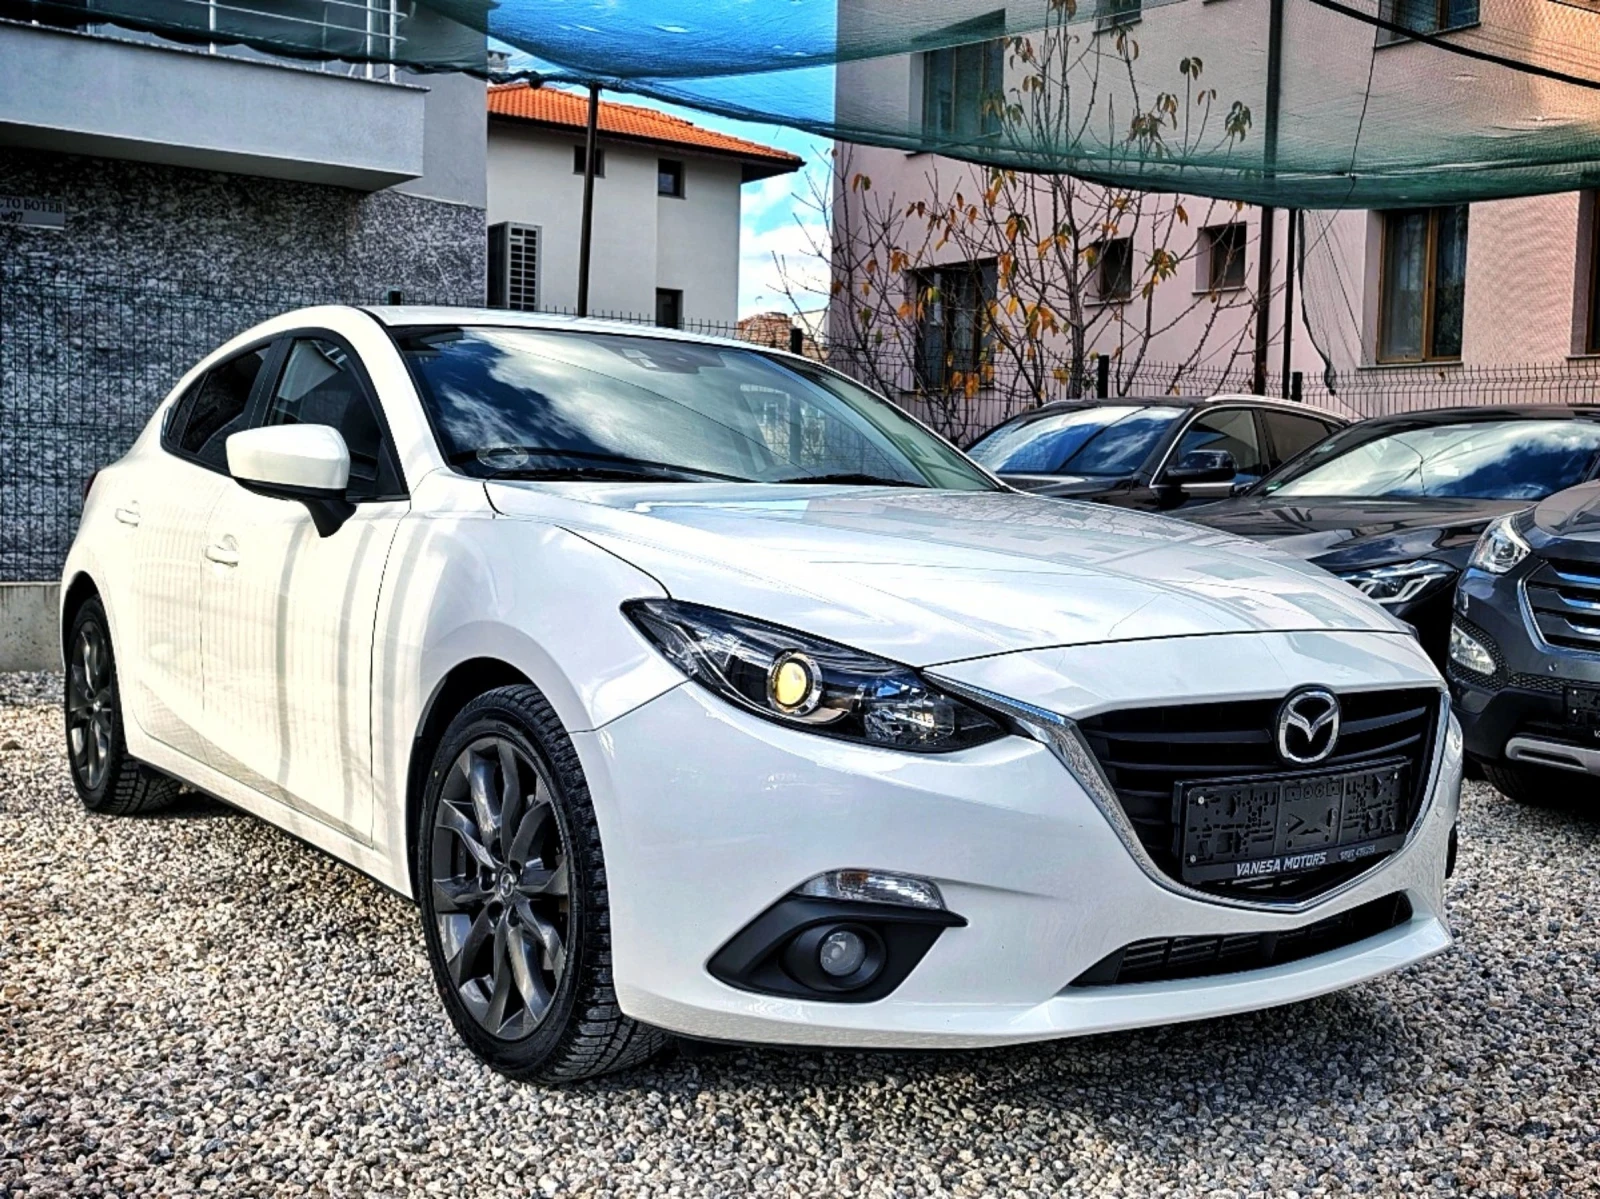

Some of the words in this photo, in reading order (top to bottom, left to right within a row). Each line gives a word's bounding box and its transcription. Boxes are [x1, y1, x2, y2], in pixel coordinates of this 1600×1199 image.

[24, 198, 63, 213] БОТЕВ
[1236, 858, 1281, 876] VANESA
[1283, 852, 1328, 870] MOTORS
